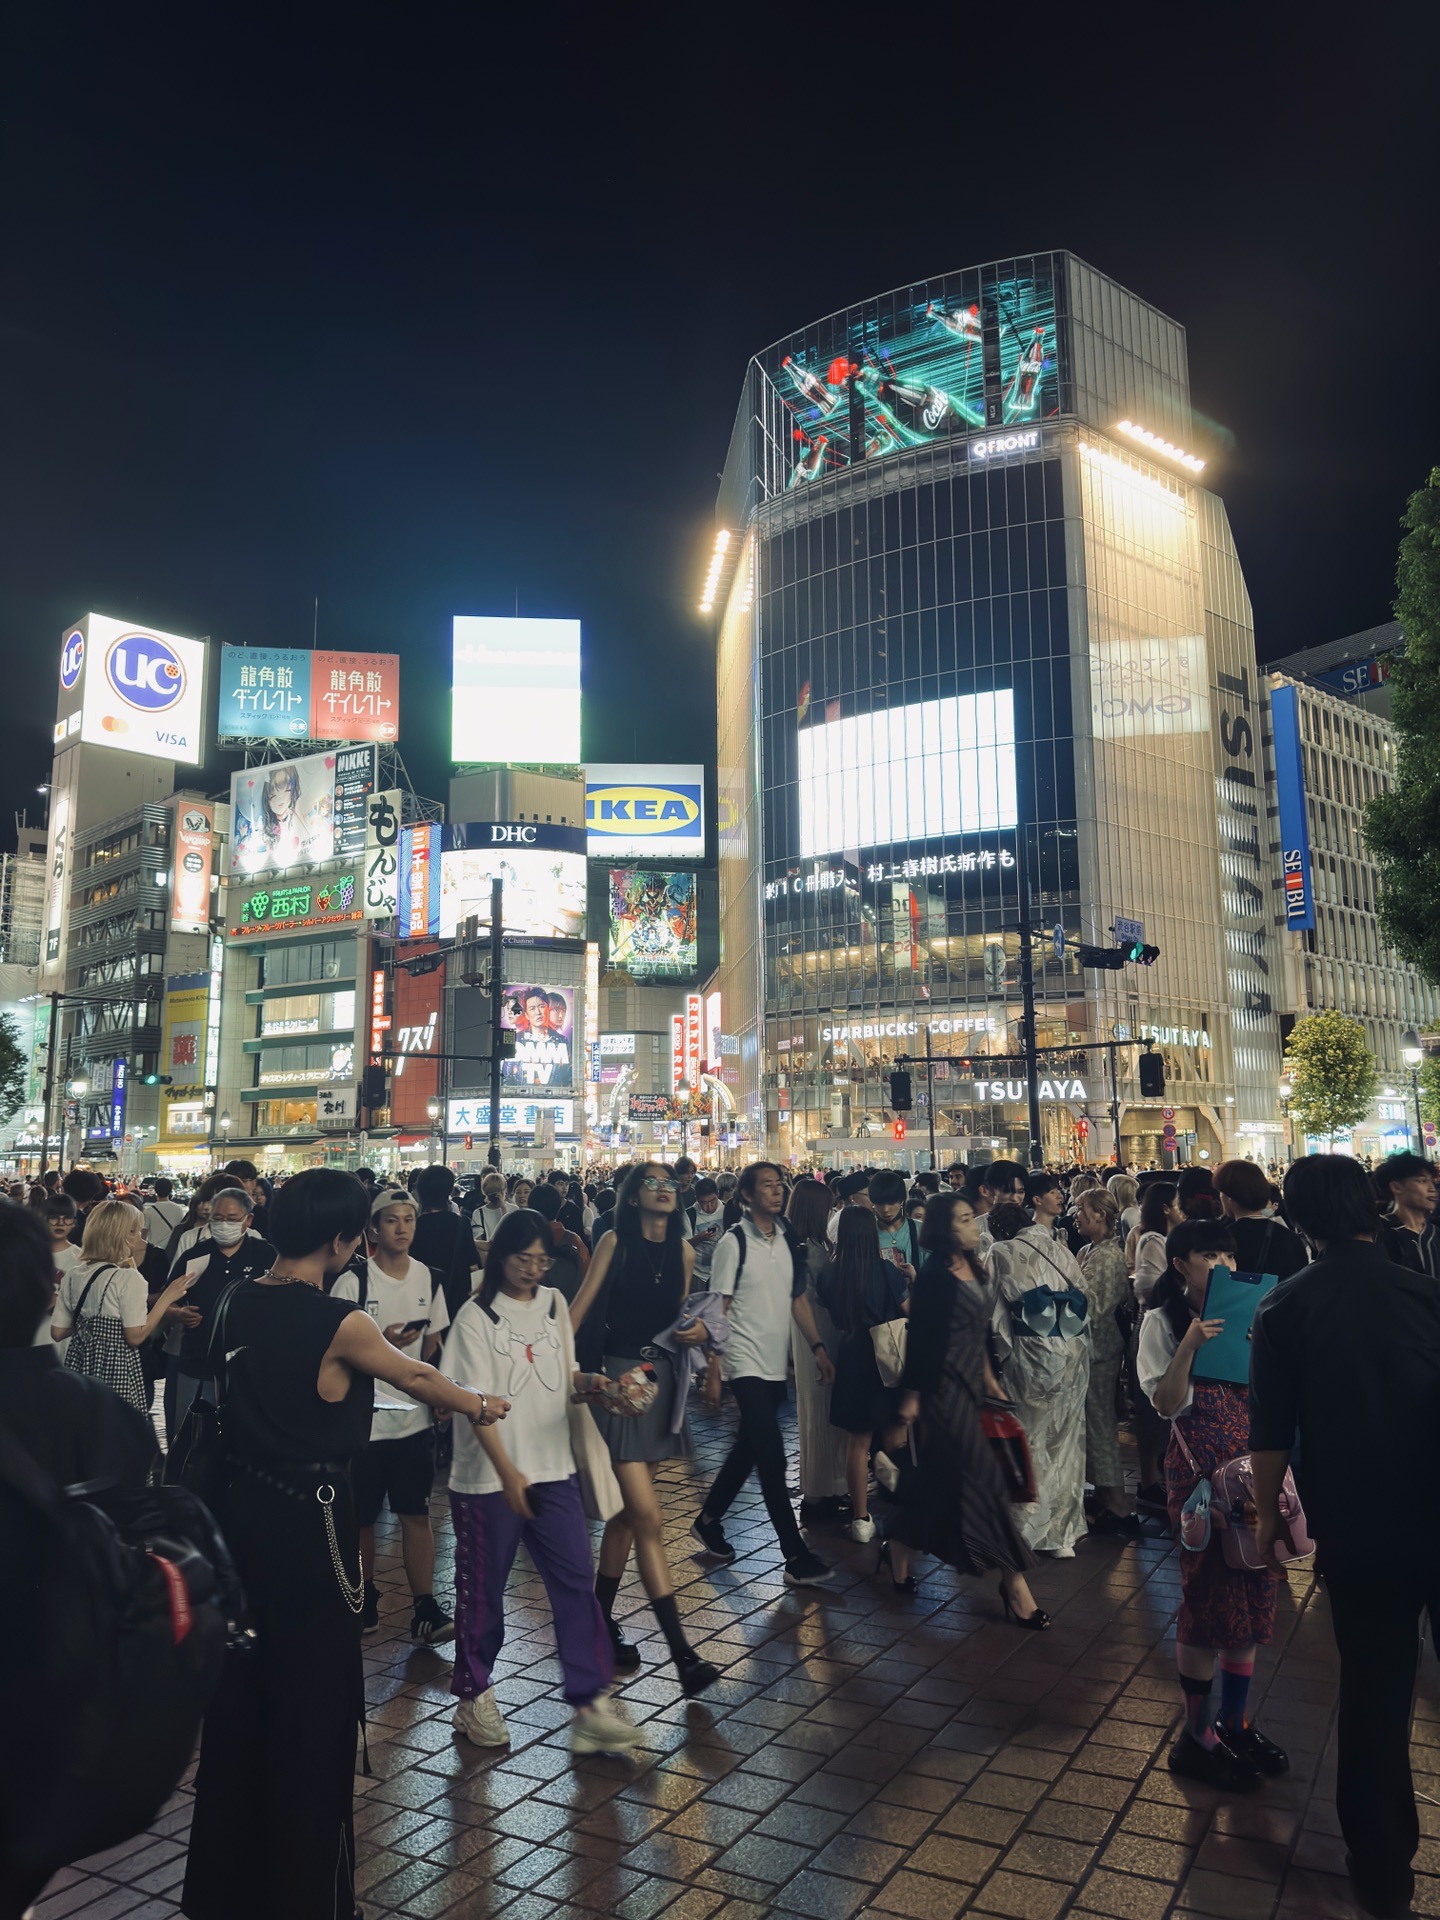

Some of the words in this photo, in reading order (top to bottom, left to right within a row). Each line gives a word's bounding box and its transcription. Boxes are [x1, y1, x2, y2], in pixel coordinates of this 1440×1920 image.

[973, 432, 1038, 457] QFRONT
[228, 652, 306, 662] のど、直接、うるおう
[318, 655, 395, 667] のど、直接、うるおう
[115, 648, 178, 695] UC
[240, 665, 293, 689] 龍角散
[330, 669, 383, 693] 龍角散
[1342, 661, 1384, 692] SEI
[232, 688, 302, 711] ダイレクト
[322, 693, 392, 716] ダイレクト
[155, 731, 187, 747] VISA
[338, 750, 370, 772] NIKKE
[586, 799, 690, 820] IKEA
[491, 825, 537, 842] DHC
[1217, 666, 1272, 1018] TSUTAYA
[367, 795, 398, 913] もんじゃ
[1283, 849, 1306, 919] SEIBU
[271, 894, 311, 918] 西村
[49, 937, 58, 951] 7F
[688, 1003, 699, 1048] カラオケ
[822, 1022, 918, 1041] STARBUCKS
[929, 1018, 996, 1035] COFFEE
[1140, 1025, 1211, 1048] TSUTAYA
[521, 1064, 554, 1084] TV
